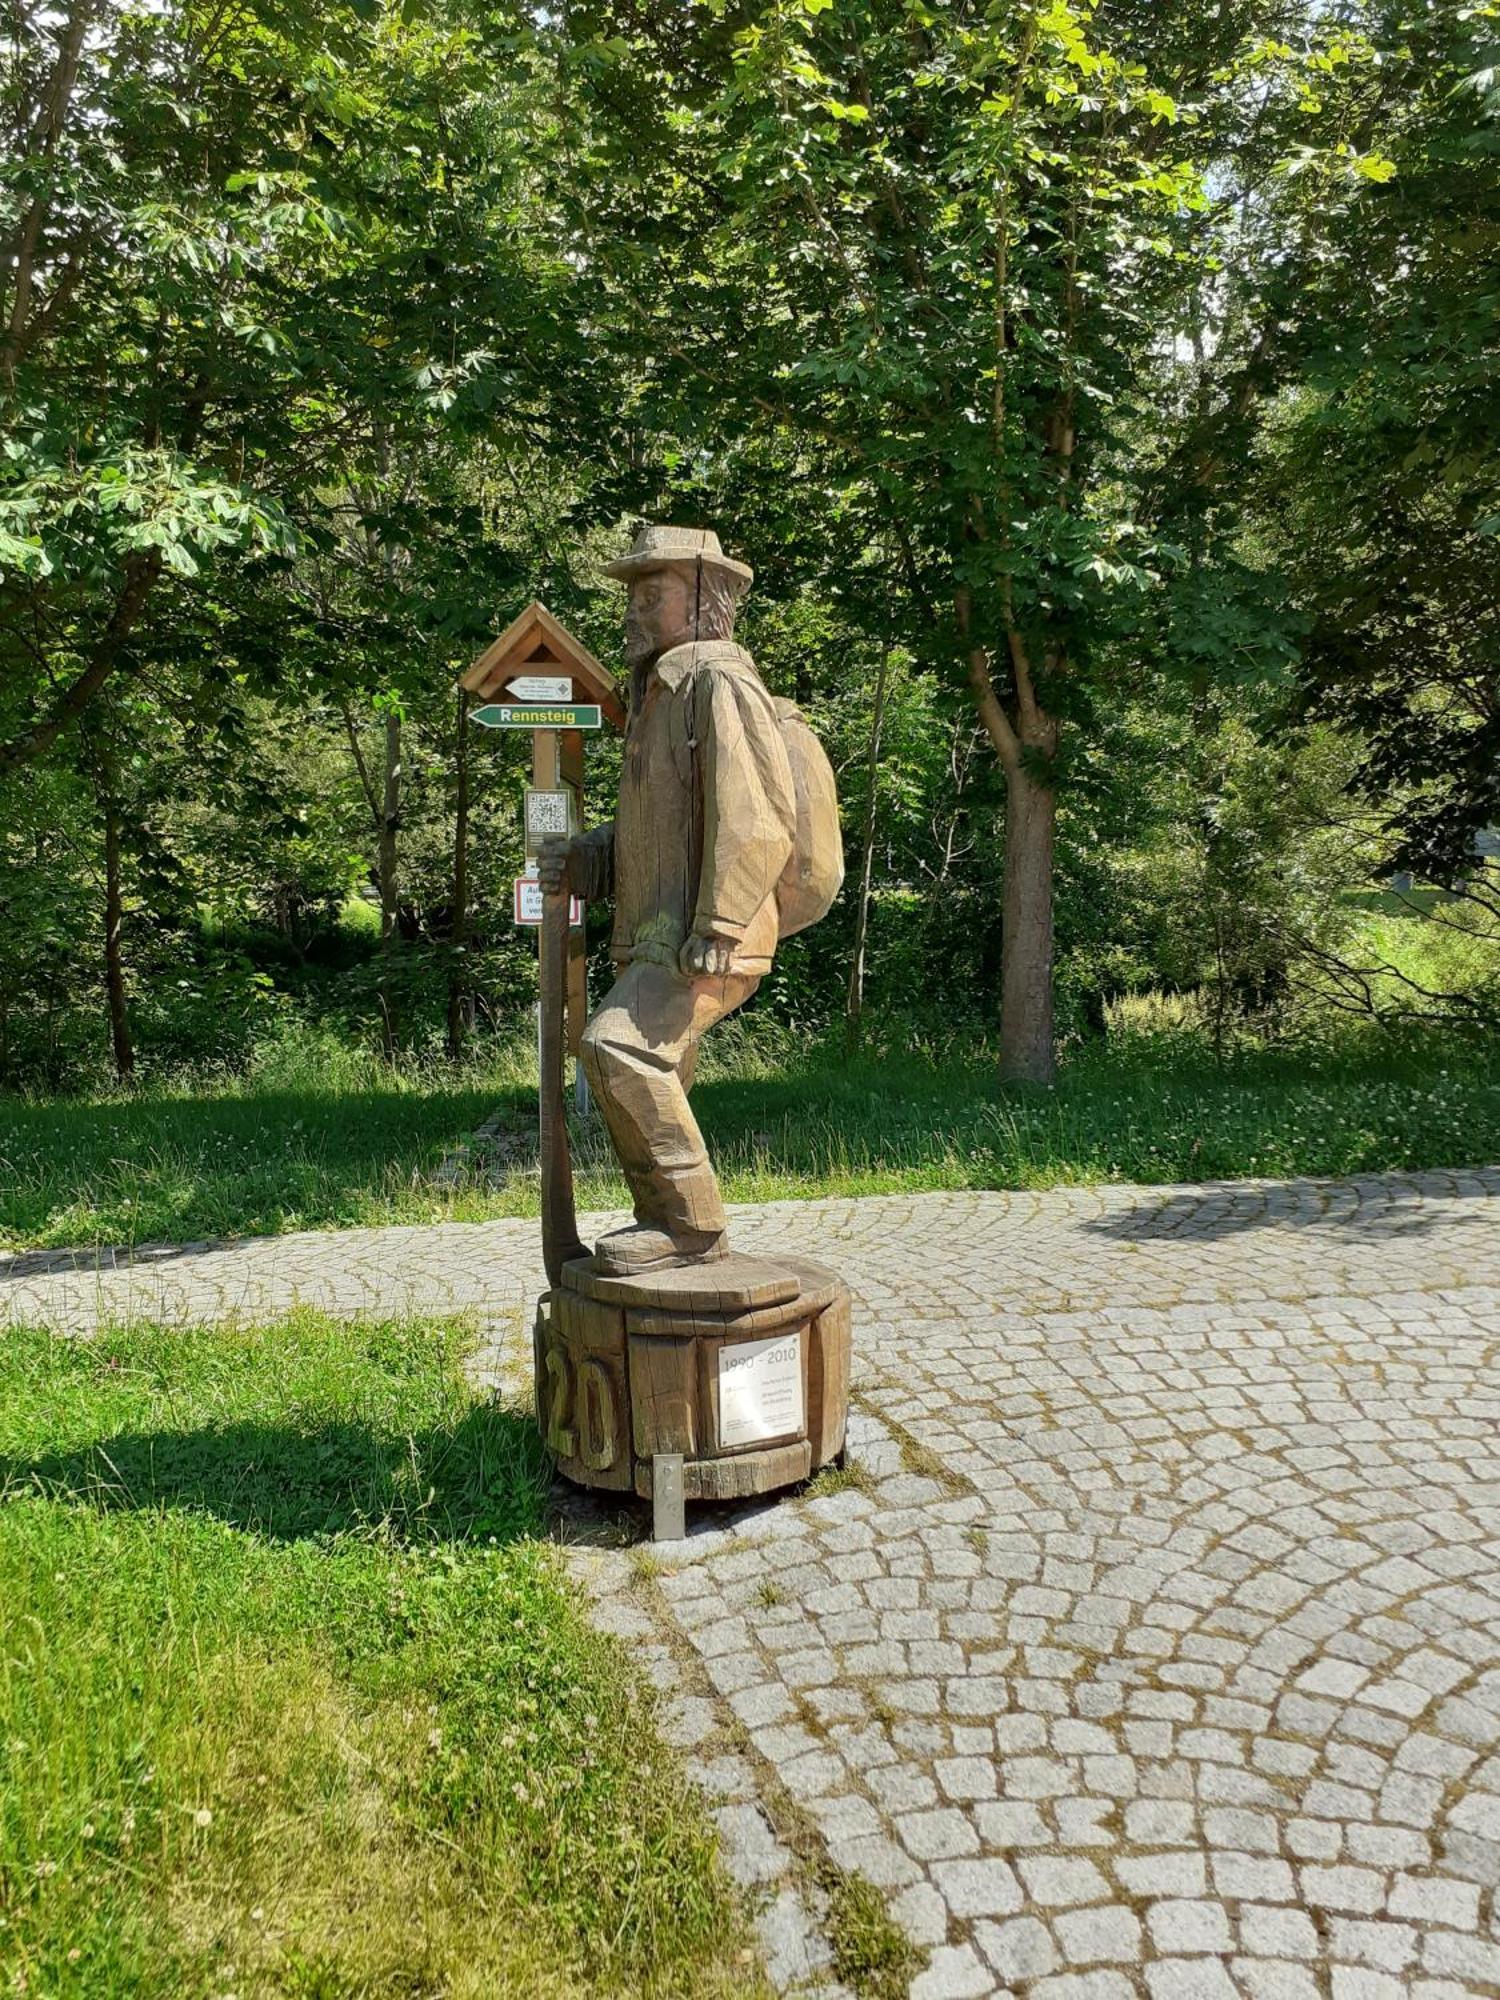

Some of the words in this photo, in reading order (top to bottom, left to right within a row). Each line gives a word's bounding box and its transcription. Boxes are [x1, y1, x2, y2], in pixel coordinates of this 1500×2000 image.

[500, 709, 575, 725] Rennsteig
[725, 1356, 754, 1372] 1990
[767, 1348, 796, 1364] 2010
